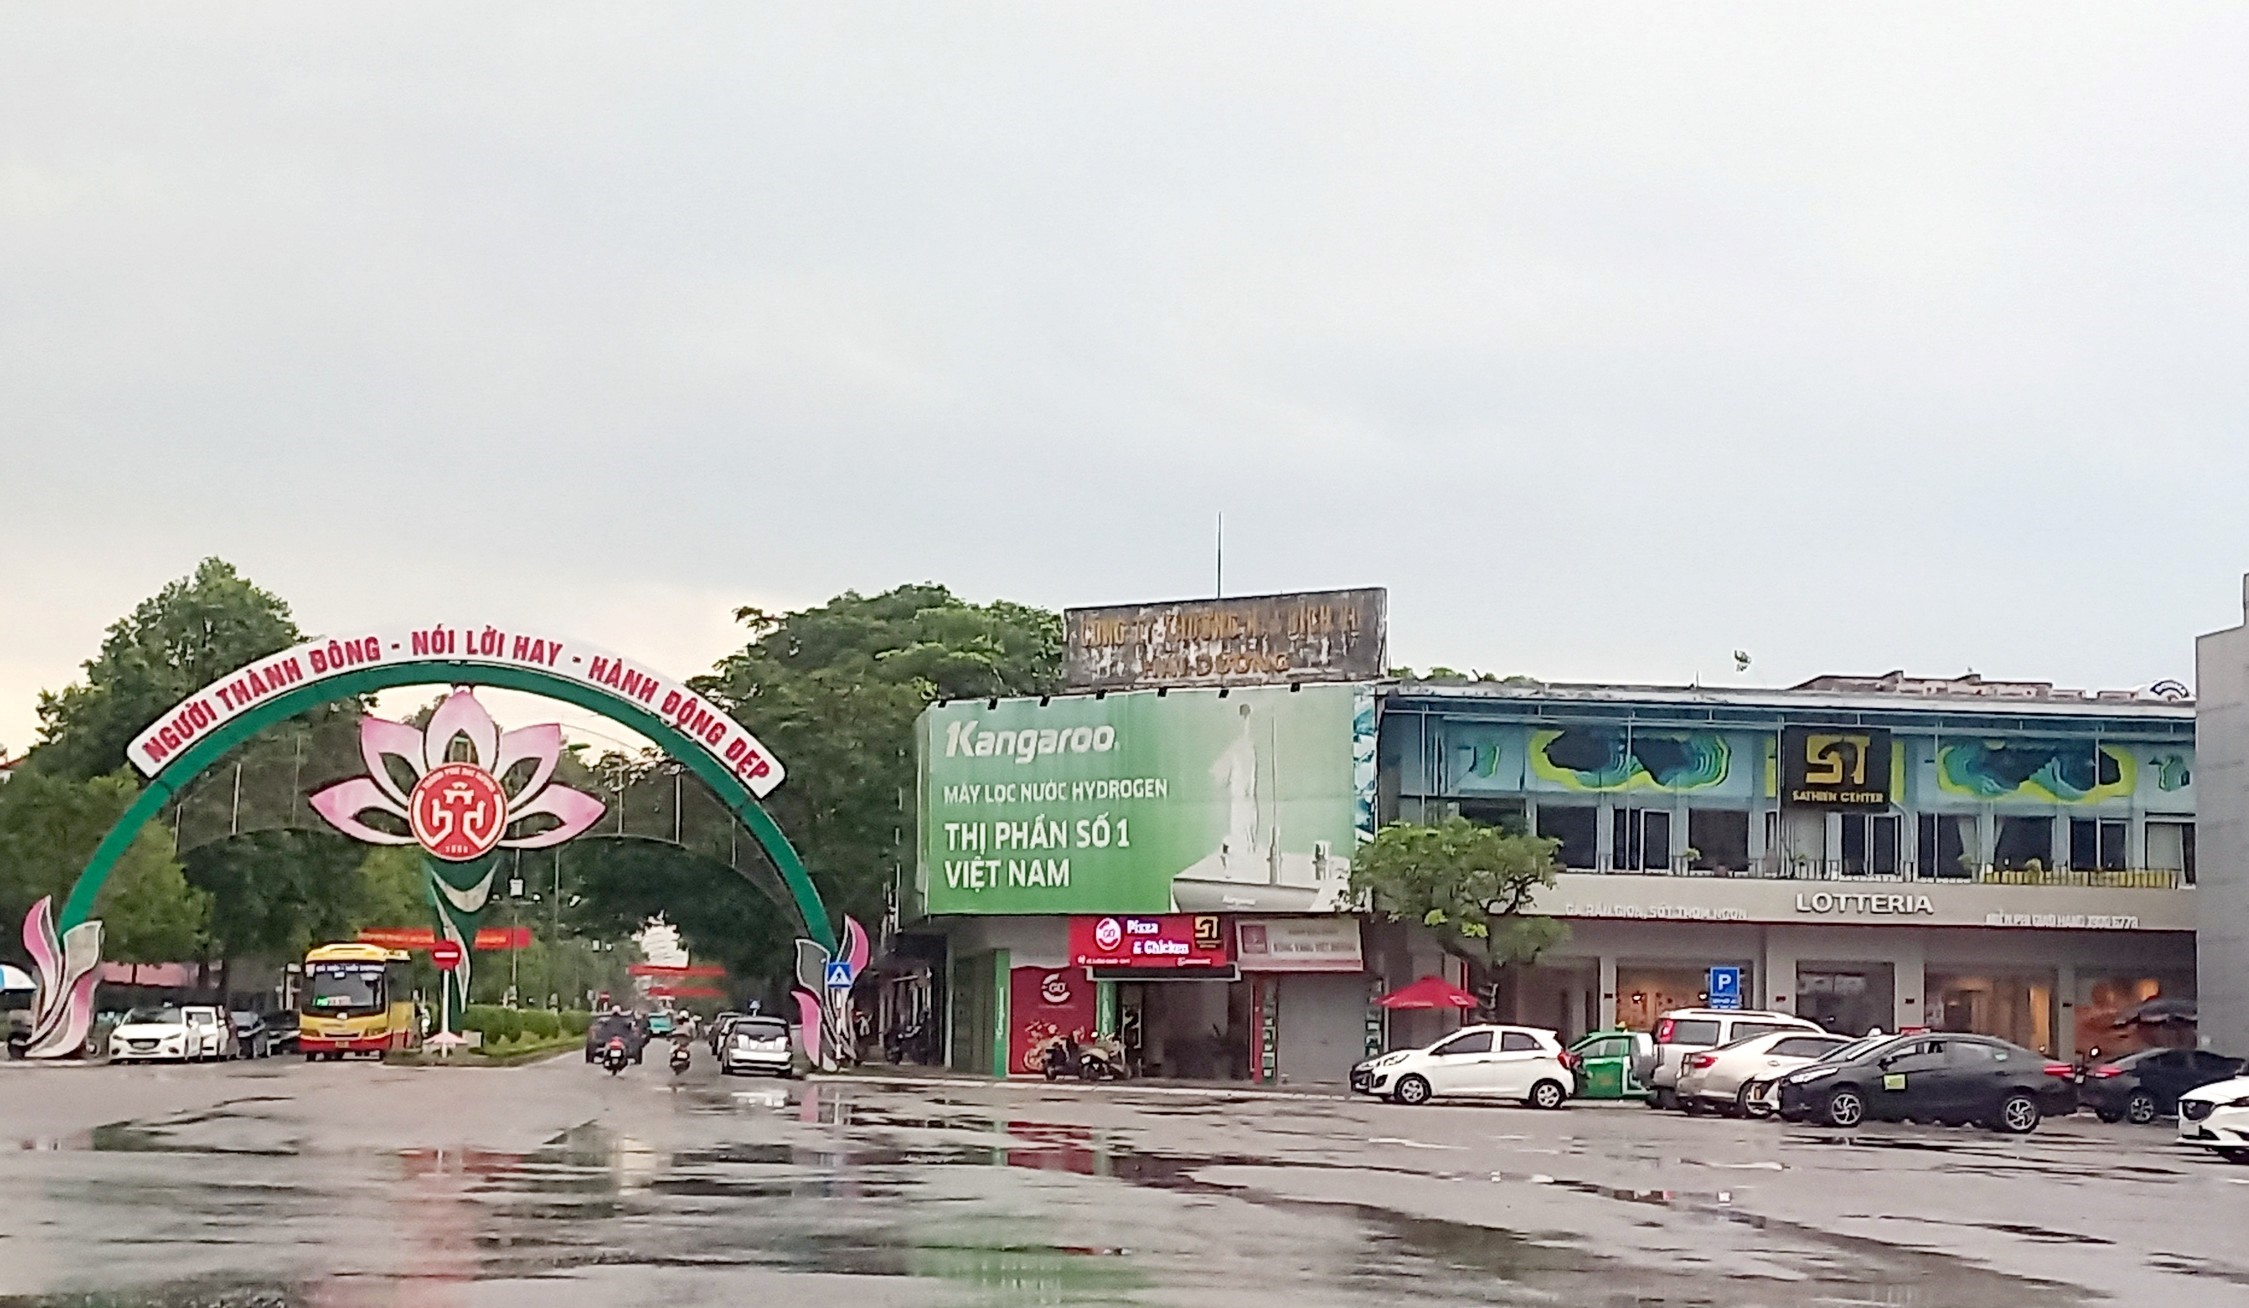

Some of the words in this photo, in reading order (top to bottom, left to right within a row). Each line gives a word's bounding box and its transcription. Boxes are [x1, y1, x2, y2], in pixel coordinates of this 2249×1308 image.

[142, 699, 218, 763] NGƯỜI
[215, 656, 303, 711] THÀNH
[308, 636, 381, 674] ĐÔNG
[411, 623, 455, 656] NÓI
[466, 625, 505, 657] LỜI
[512, 635, 563, 667] HAY
[588, 656, 659, 703] HÀNH
[660, 689, 727, 747] ĐỘNG
[724, 737, 770, 779] ĐẸP
[945, 720, 1116, 764] Kangaroo
[943, 780, 981, 804] MÁY
[984, 783, 1016, 806] LỌC
[1021, 779, 1067, 803] NƯỚC
[1072, 778, 1168, 801] HYDROGEN
[1840, 791, 1884, 803] CENTER
[944, 822, 987, 855] THỊ
[995, 813, 1067, 850] PHẦN
[1076, 812, 1110, 848] SỐ
[1116, 818, 1130, 847] 1
[944, 856, 1001, 893] VIỆT
[1008, 858, 1070, 888] NAM
[1796, 892, 1935, 914] LOTTERIA
[1718, 974, 1732, 991] P
